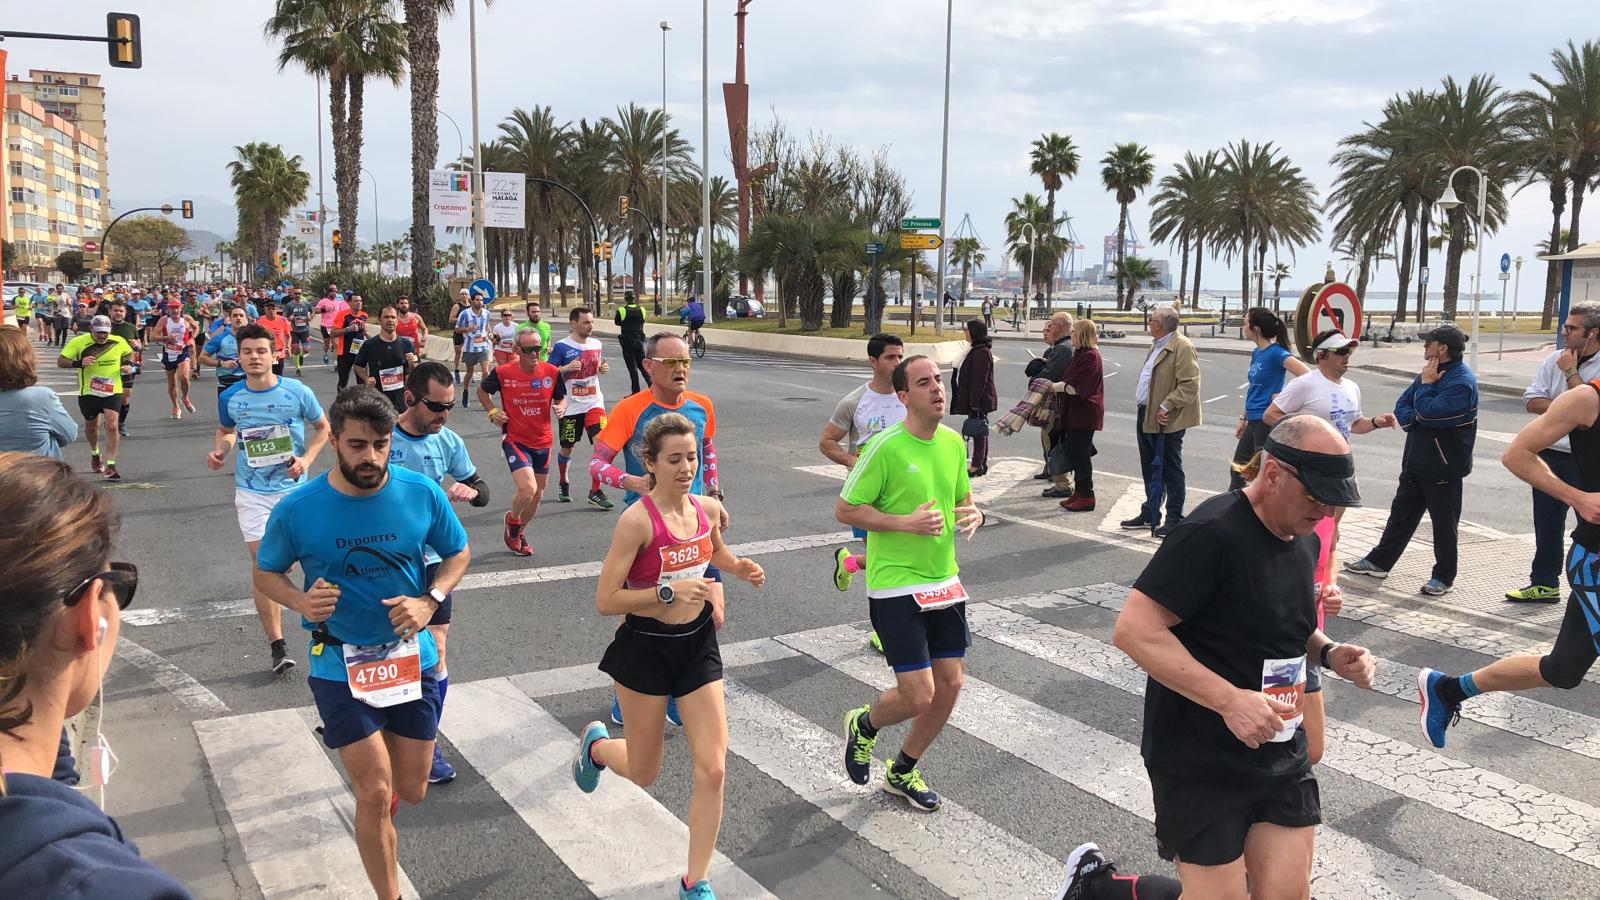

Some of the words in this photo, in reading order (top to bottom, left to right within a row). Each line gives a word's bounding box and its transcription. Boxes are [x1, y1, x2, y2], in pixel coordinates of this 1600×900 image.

[433, 203, 467, 212] Cruzcampo
[564, 419, 576, 443] SWEEP
[249, 441, 276, 454] 1123
[335, 532, 397, 549] DEPORTES
[668, 545, 700, 565] 3629
[355, 663, 399, 685] 4790
